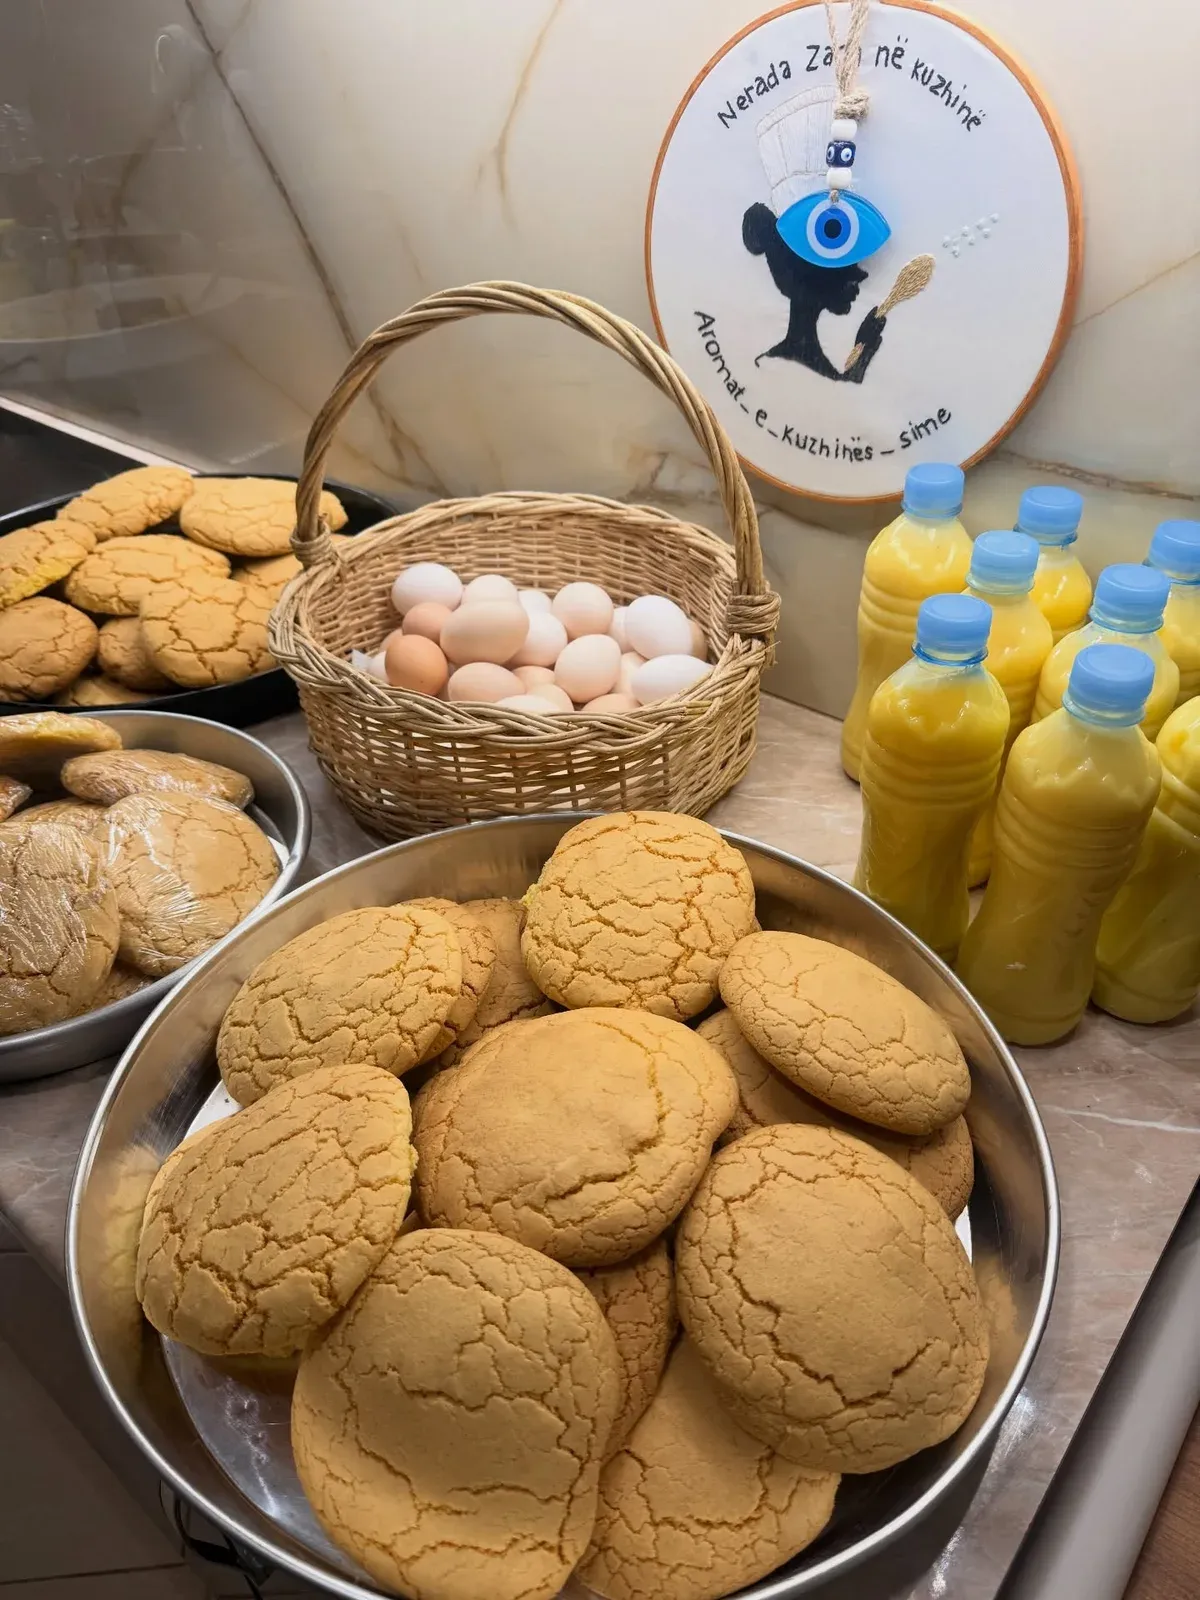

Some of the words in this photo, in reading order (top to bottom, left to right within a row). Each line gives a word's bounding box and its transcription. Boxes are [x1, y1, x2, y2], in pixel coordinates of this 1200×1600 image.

[717, 60, 792, 129] Nerada
[806, 44, 862, 72] Za
[875, 34, 908, 70] në
